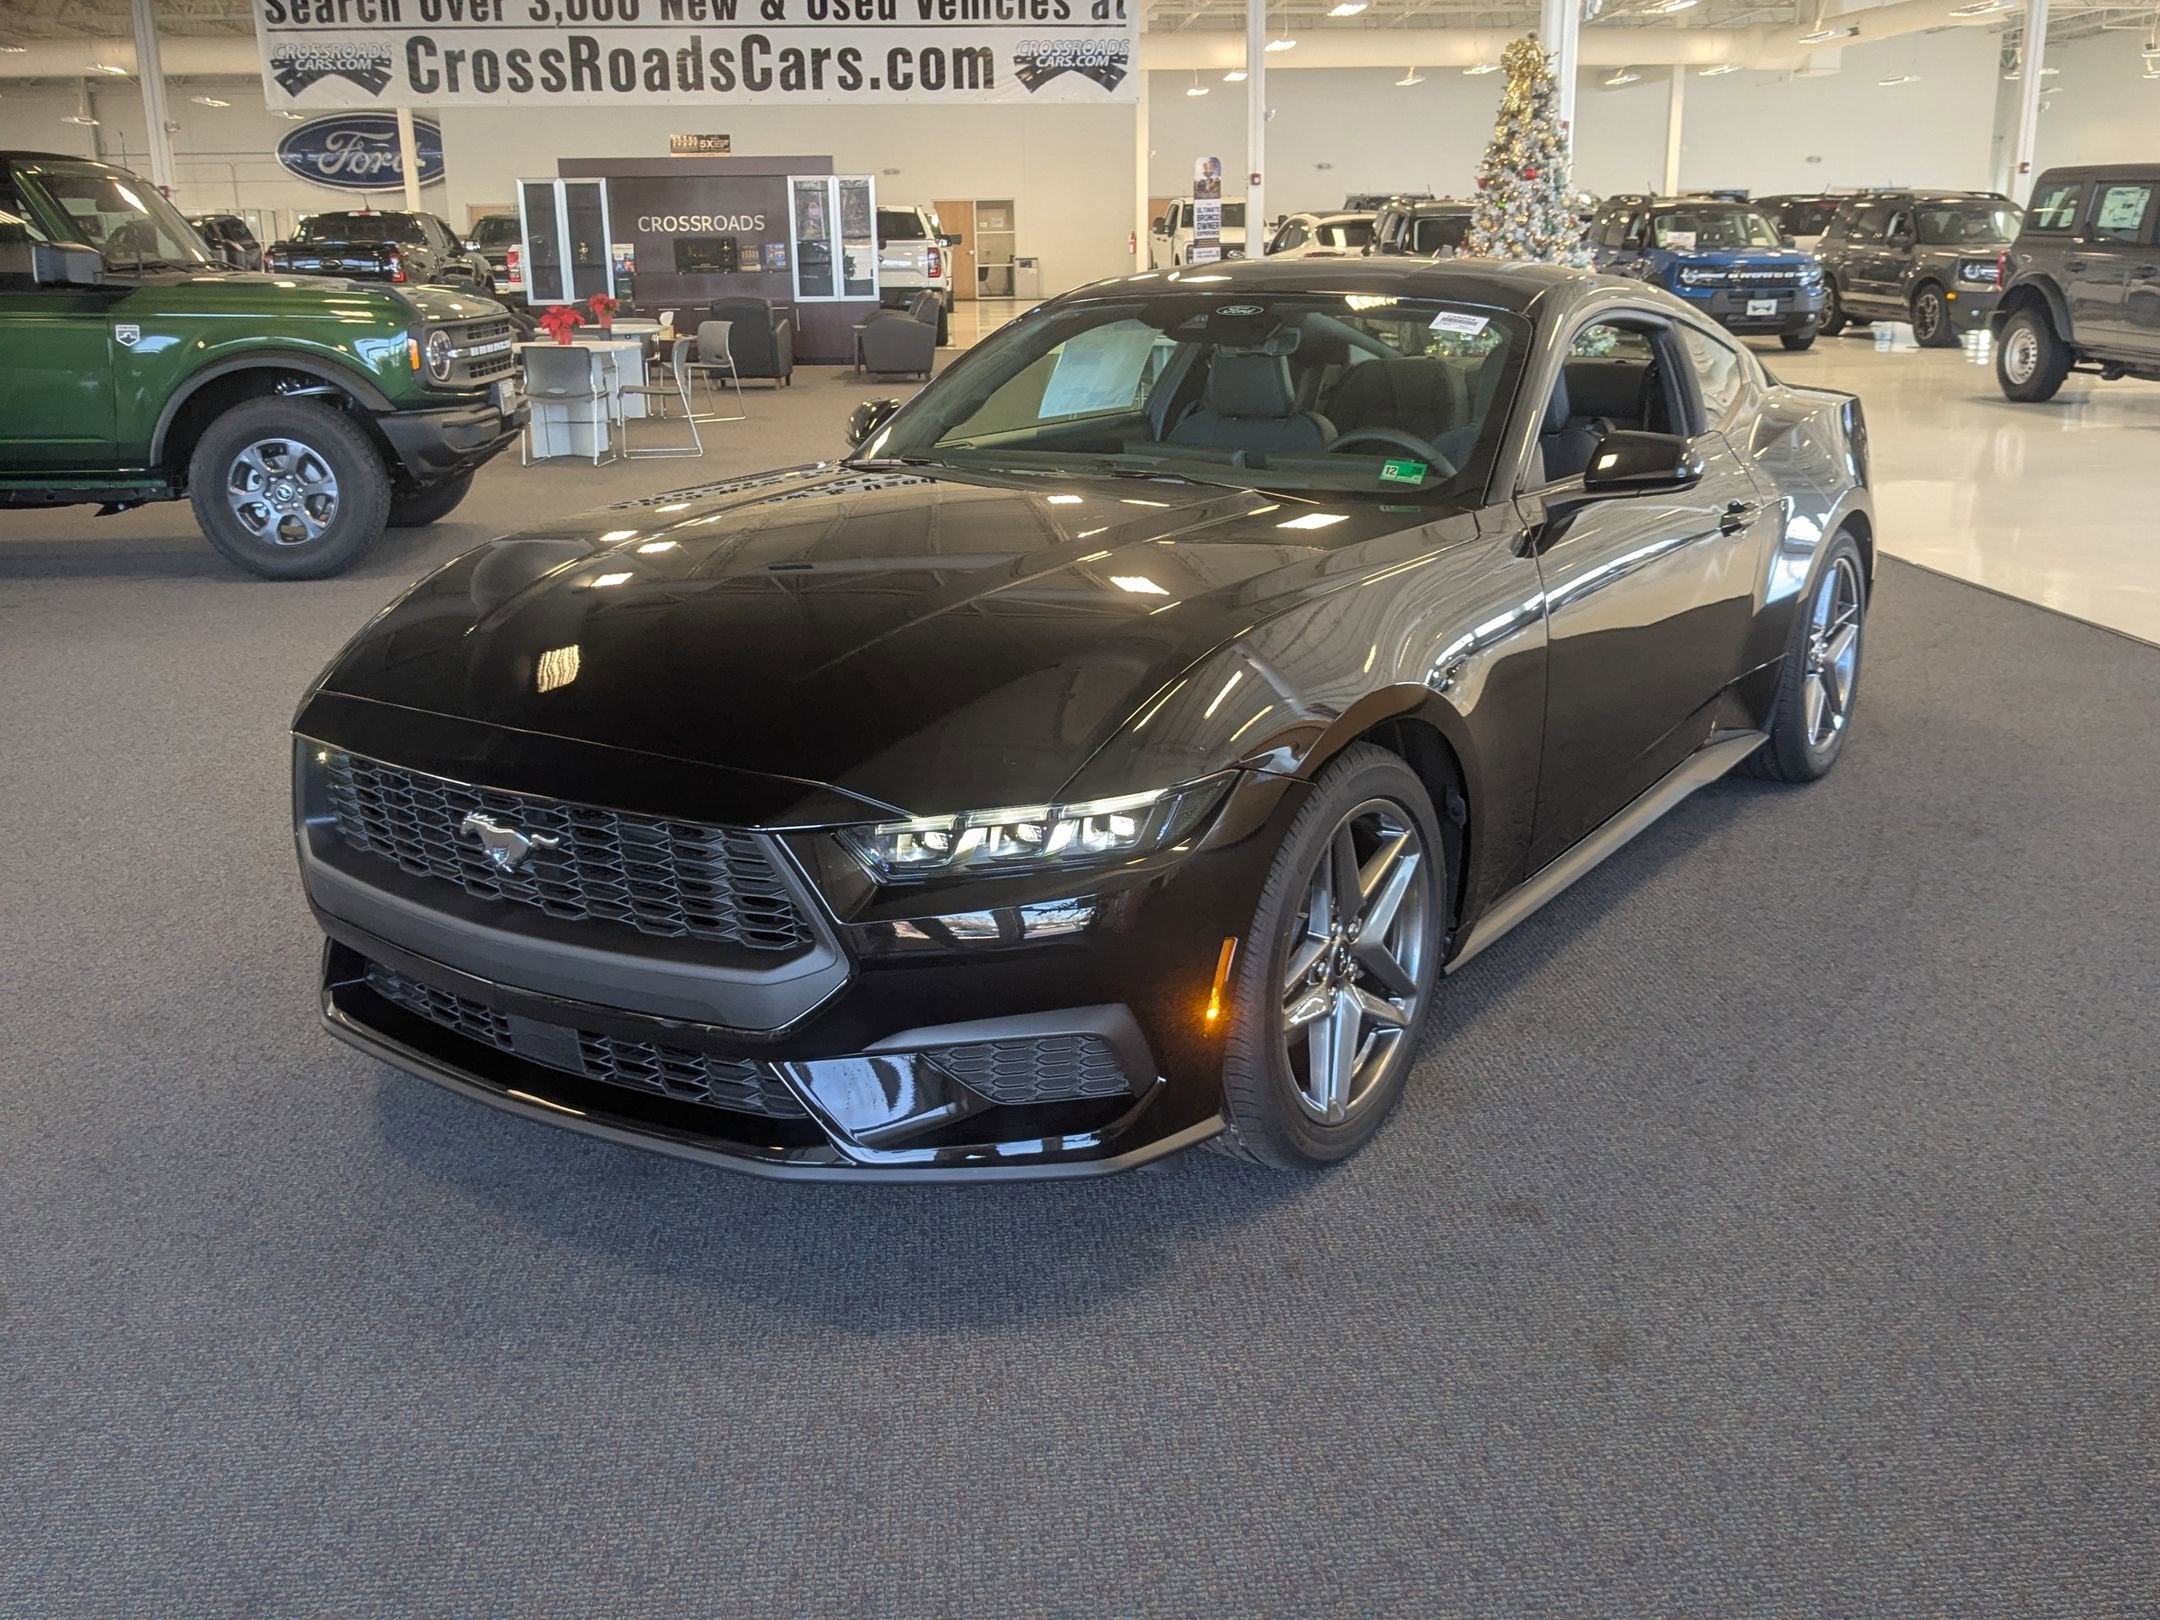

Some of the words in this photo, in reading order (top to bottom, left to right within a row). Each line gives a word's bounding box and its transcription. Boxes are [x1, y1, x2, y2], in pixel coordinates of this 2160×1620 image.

[264, 0, 401, 24] Search
[660, 0, 738, 21] New
[760, 0, 786, 21] &
[272, 42, 393, 60] CROSSROADS
[1016, 39, 1131, 57] CROSSROADS
[295, 58, 372, 71] CARS.COM
[406, 34, 995, 94] CrossRoadsCars.com
[1036, 55, 1110, 67] CARS.COM
[638, 214, 766, 233] CROSSROADS
[1385, 466, 1398, 476] 12
